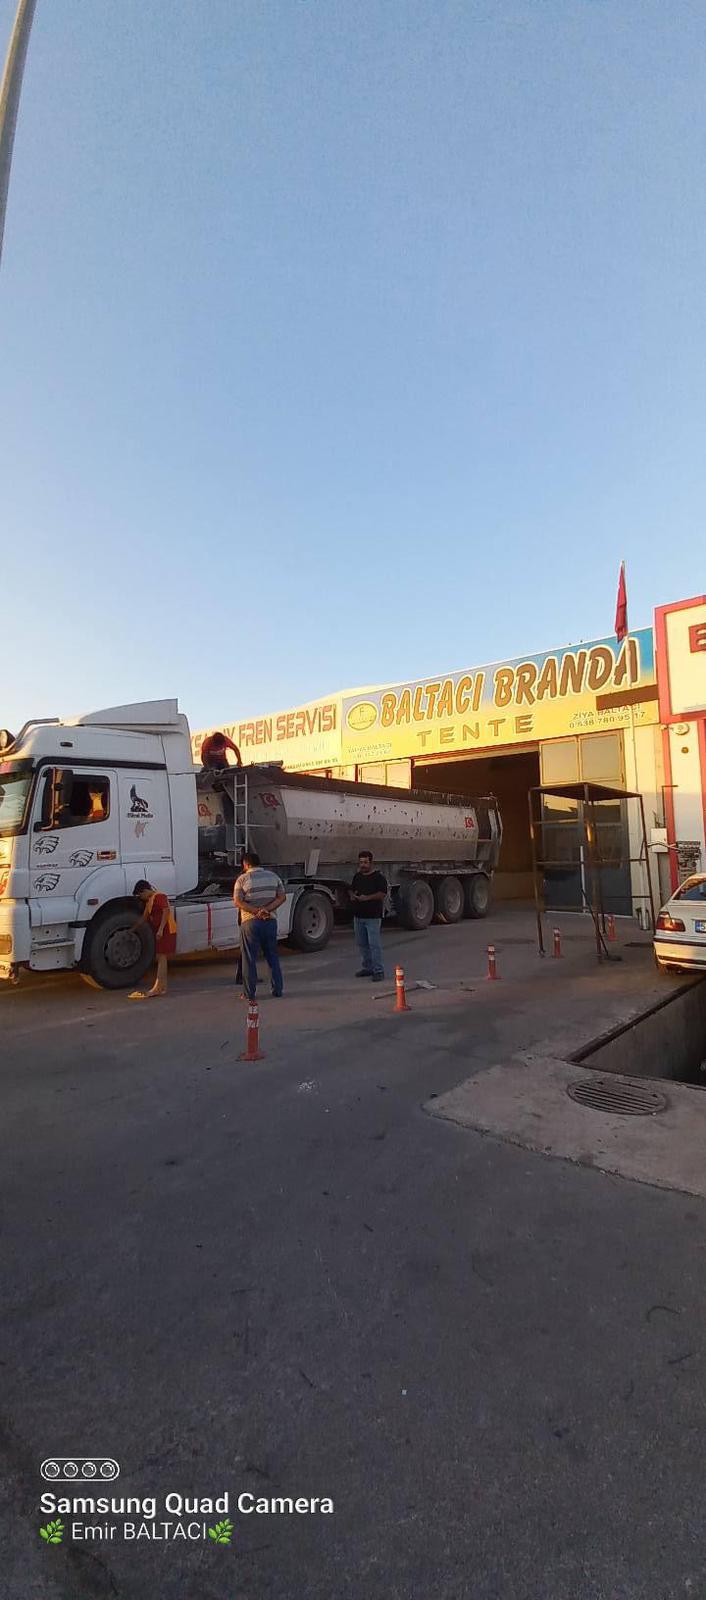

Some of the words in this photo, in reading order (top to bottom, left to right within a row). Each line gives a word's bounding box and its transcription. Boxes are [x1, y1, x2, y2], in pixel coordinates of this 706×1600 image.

[381, 673, 484, 727] BALTACI
[494, 640, 638, 708] BRANDA
[239, 718, 273, 748] FREN
[416, 714, 533, 747] TENTE
